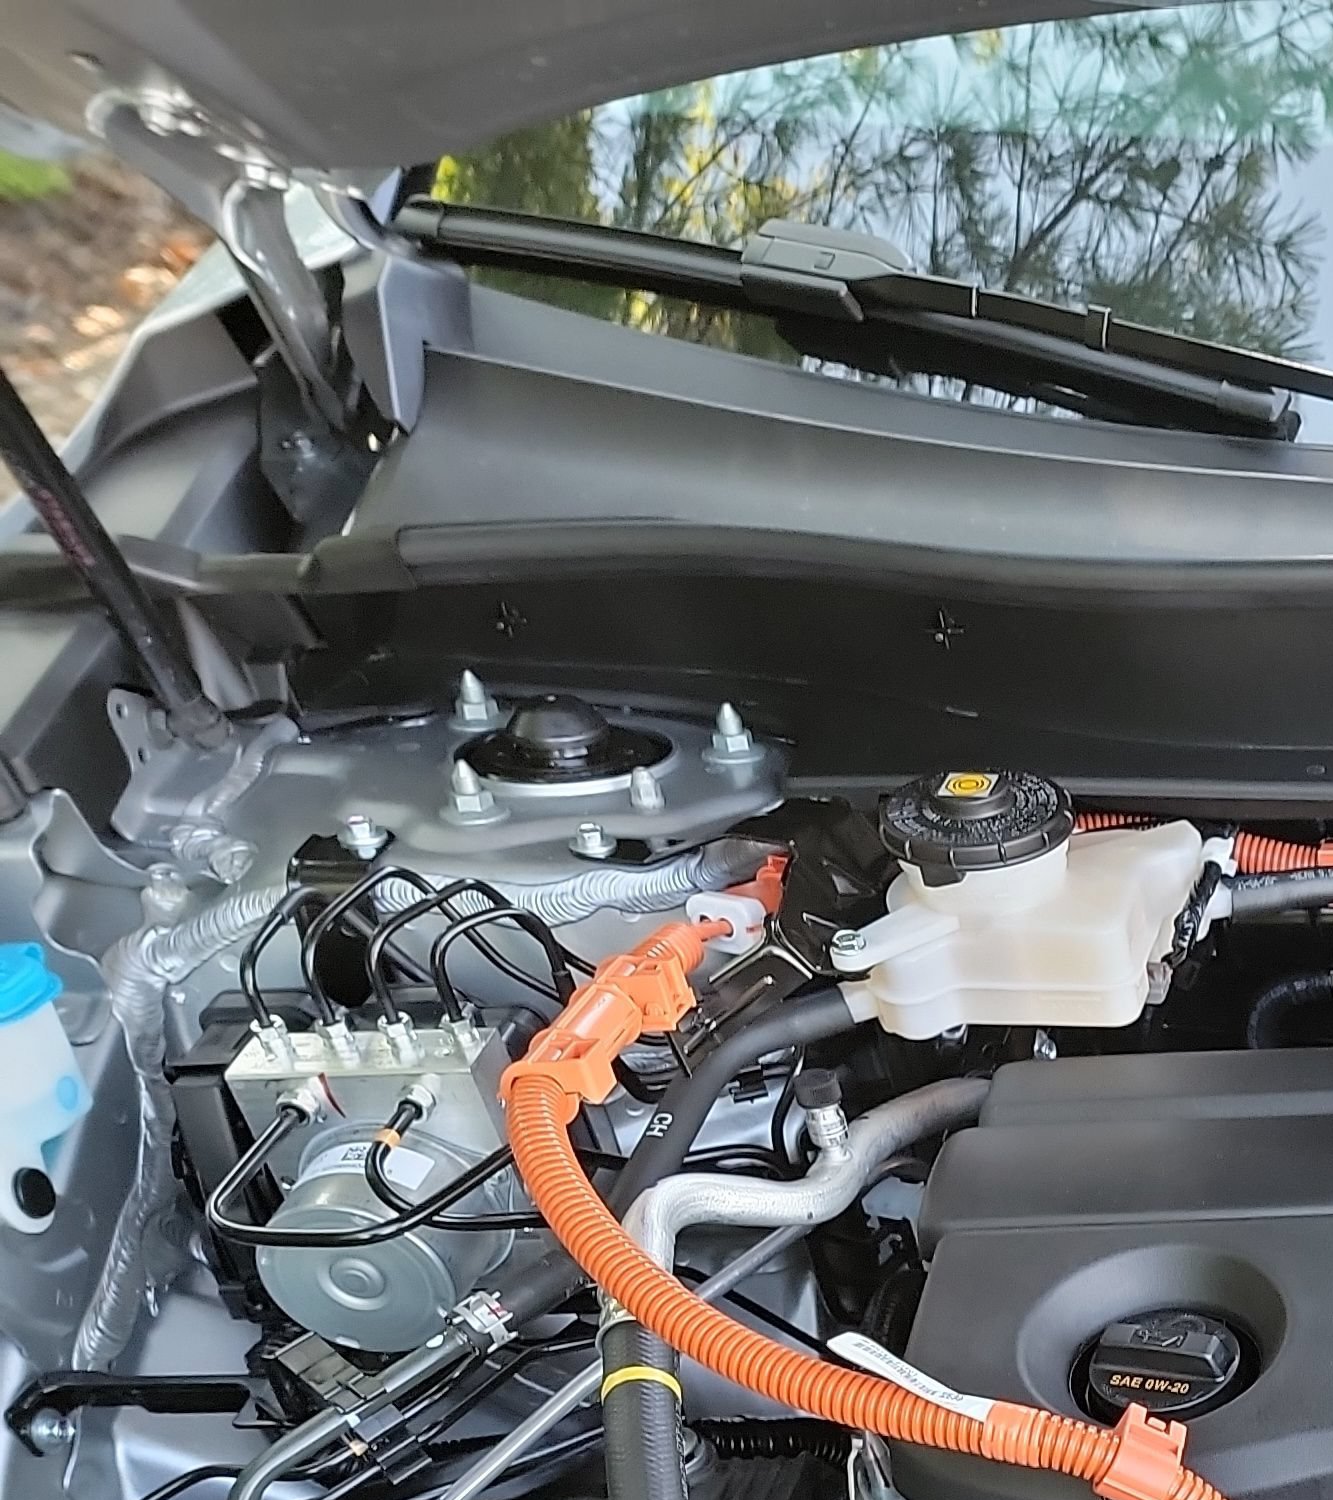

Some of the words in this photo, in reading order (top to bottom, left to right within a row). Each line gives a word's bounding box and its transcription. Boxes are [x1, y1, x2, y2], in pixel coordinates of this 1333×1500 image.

[646, 1112, 674, 1138] CH
[1109, 1374, 1143, 1387] SAE
[1145, 1379, 1190, 1394] 0W-20
